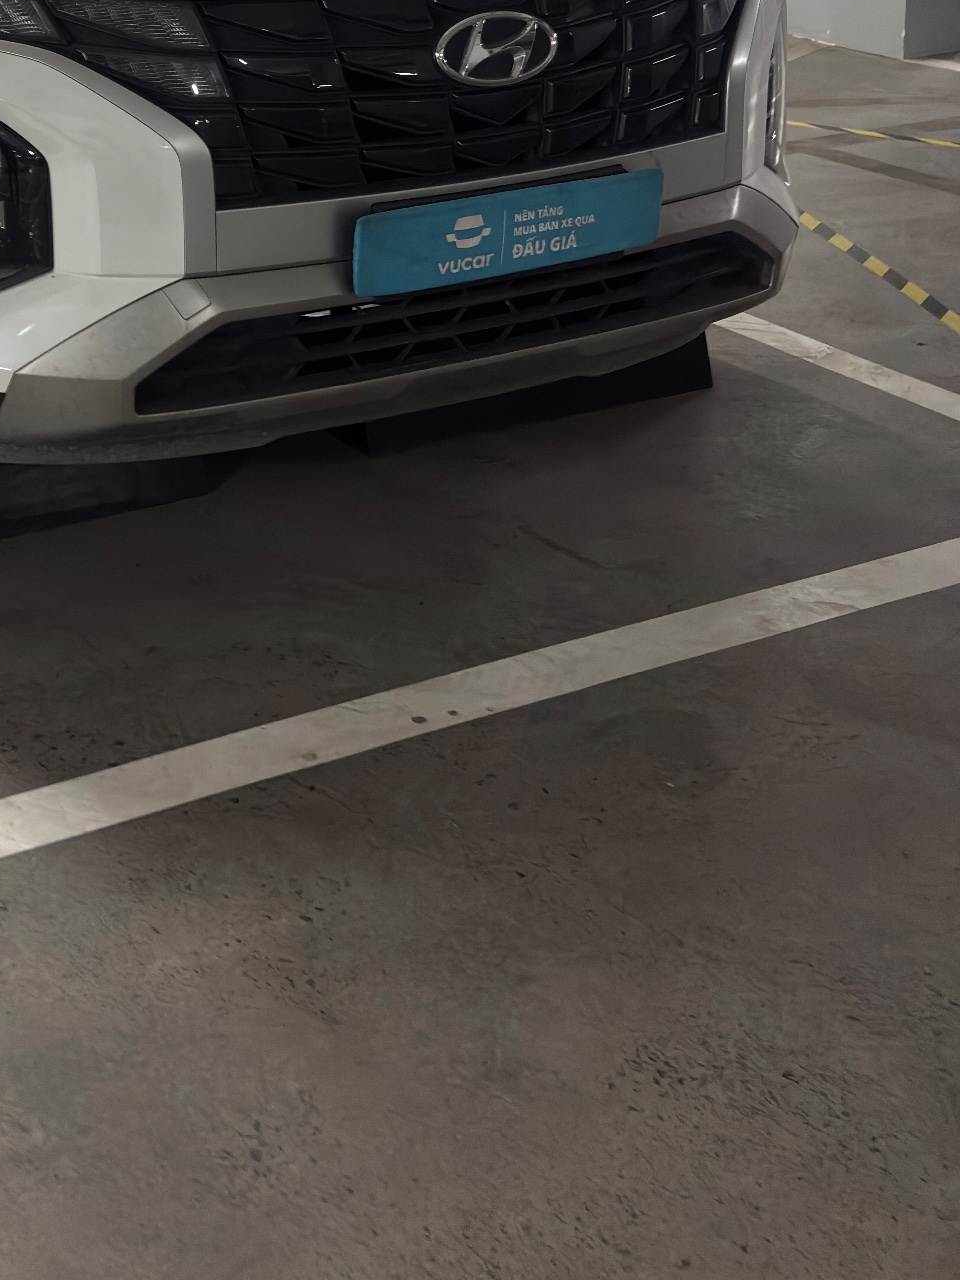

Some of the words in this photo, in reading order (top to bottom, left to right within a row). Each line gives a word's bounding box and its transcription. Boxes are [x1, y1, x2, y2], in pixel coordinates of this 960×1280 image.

[537, 205, 564, 219] TẢNG
[513, 223, 537, 237] MUA
[538, 219, 559, 233] BÁN
[560, 217, 573, 229] XE
[574, 214, 596, 227] QUA
[512, 235, 546, 260] ĐẤU
[549, 229, 577, 252] GIÁ
[437, 253, 496, 275] vucar
